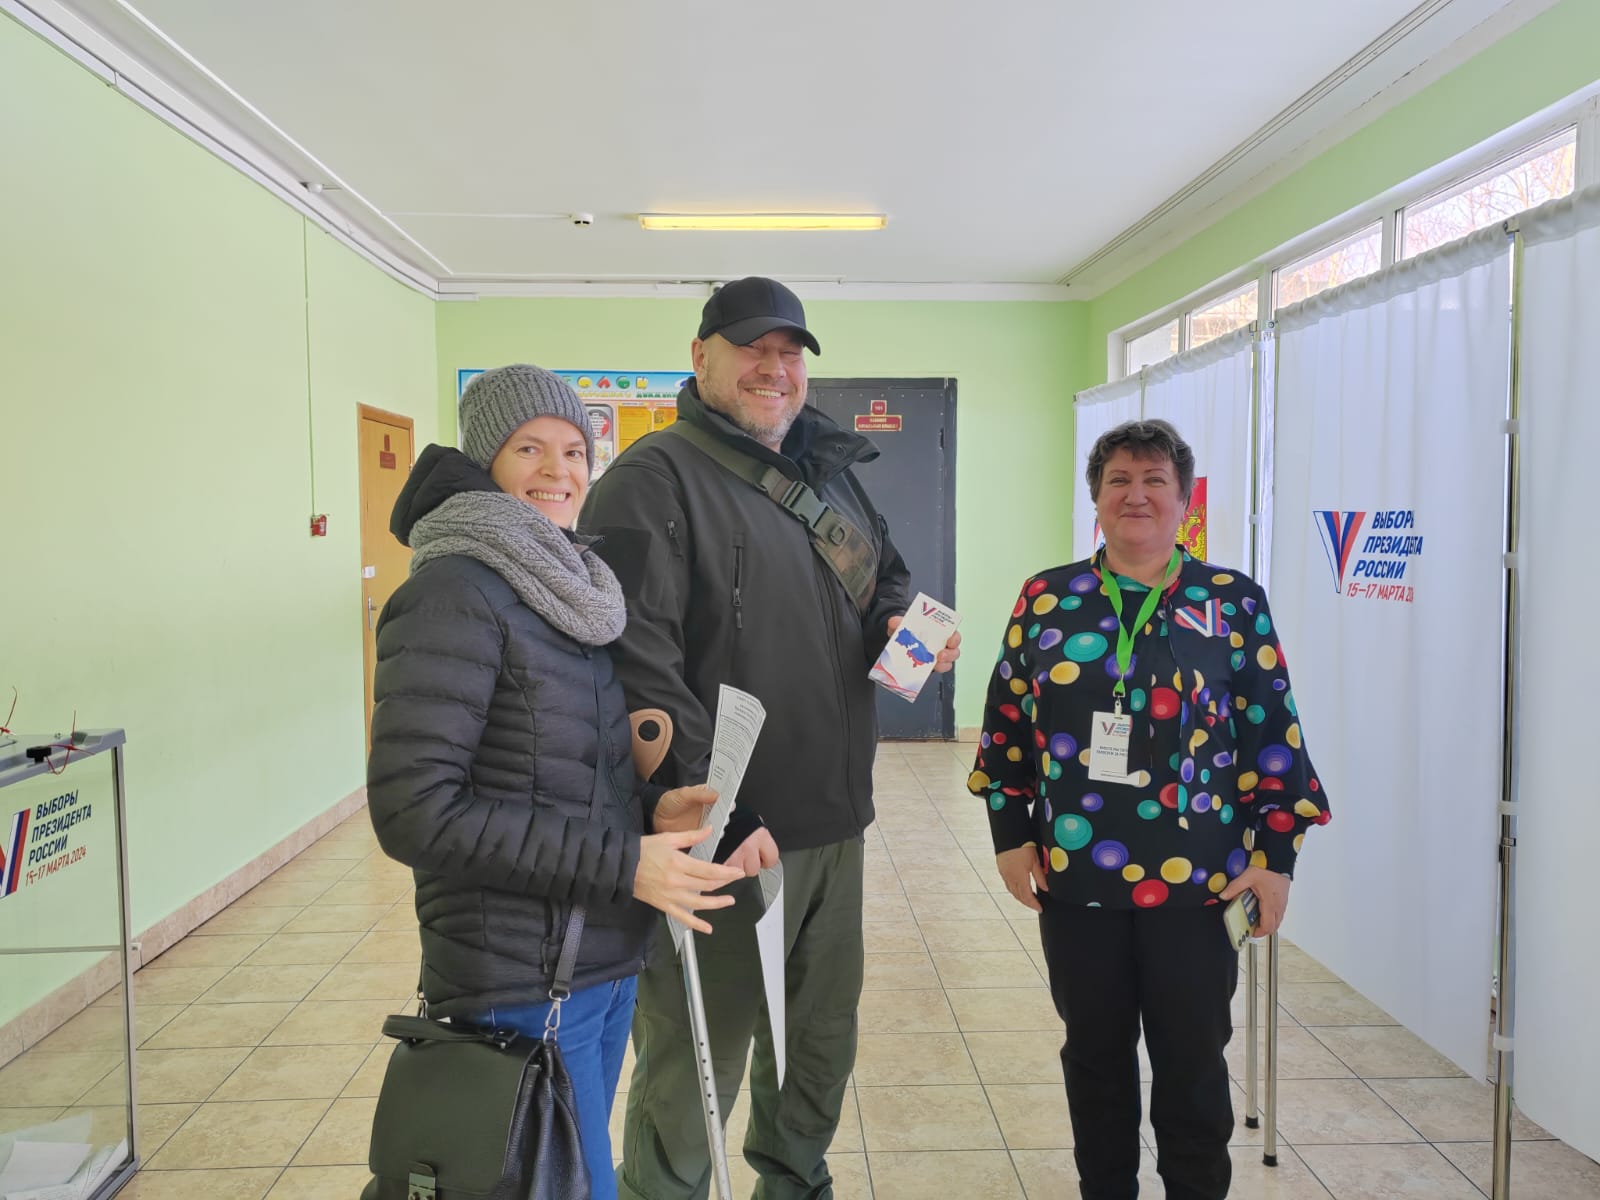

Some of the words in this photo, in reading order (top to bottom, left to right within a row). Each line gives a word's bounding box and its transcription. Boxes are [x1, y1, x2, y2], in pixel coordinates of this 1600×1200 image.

[1353, 560, 1406, 579] РОССИИ
[1377, 584, 1404, 602] МАРТА
[36, 789, 79, 820] ВЫБОРЫ
[31, 804, 92, 843] ПРЕЗИДЕНТА
[28, 834, 68, 866] РОССИИ
[46, 854, 70, 877] МАРТА
[70, 845, 87, 865] 2024
